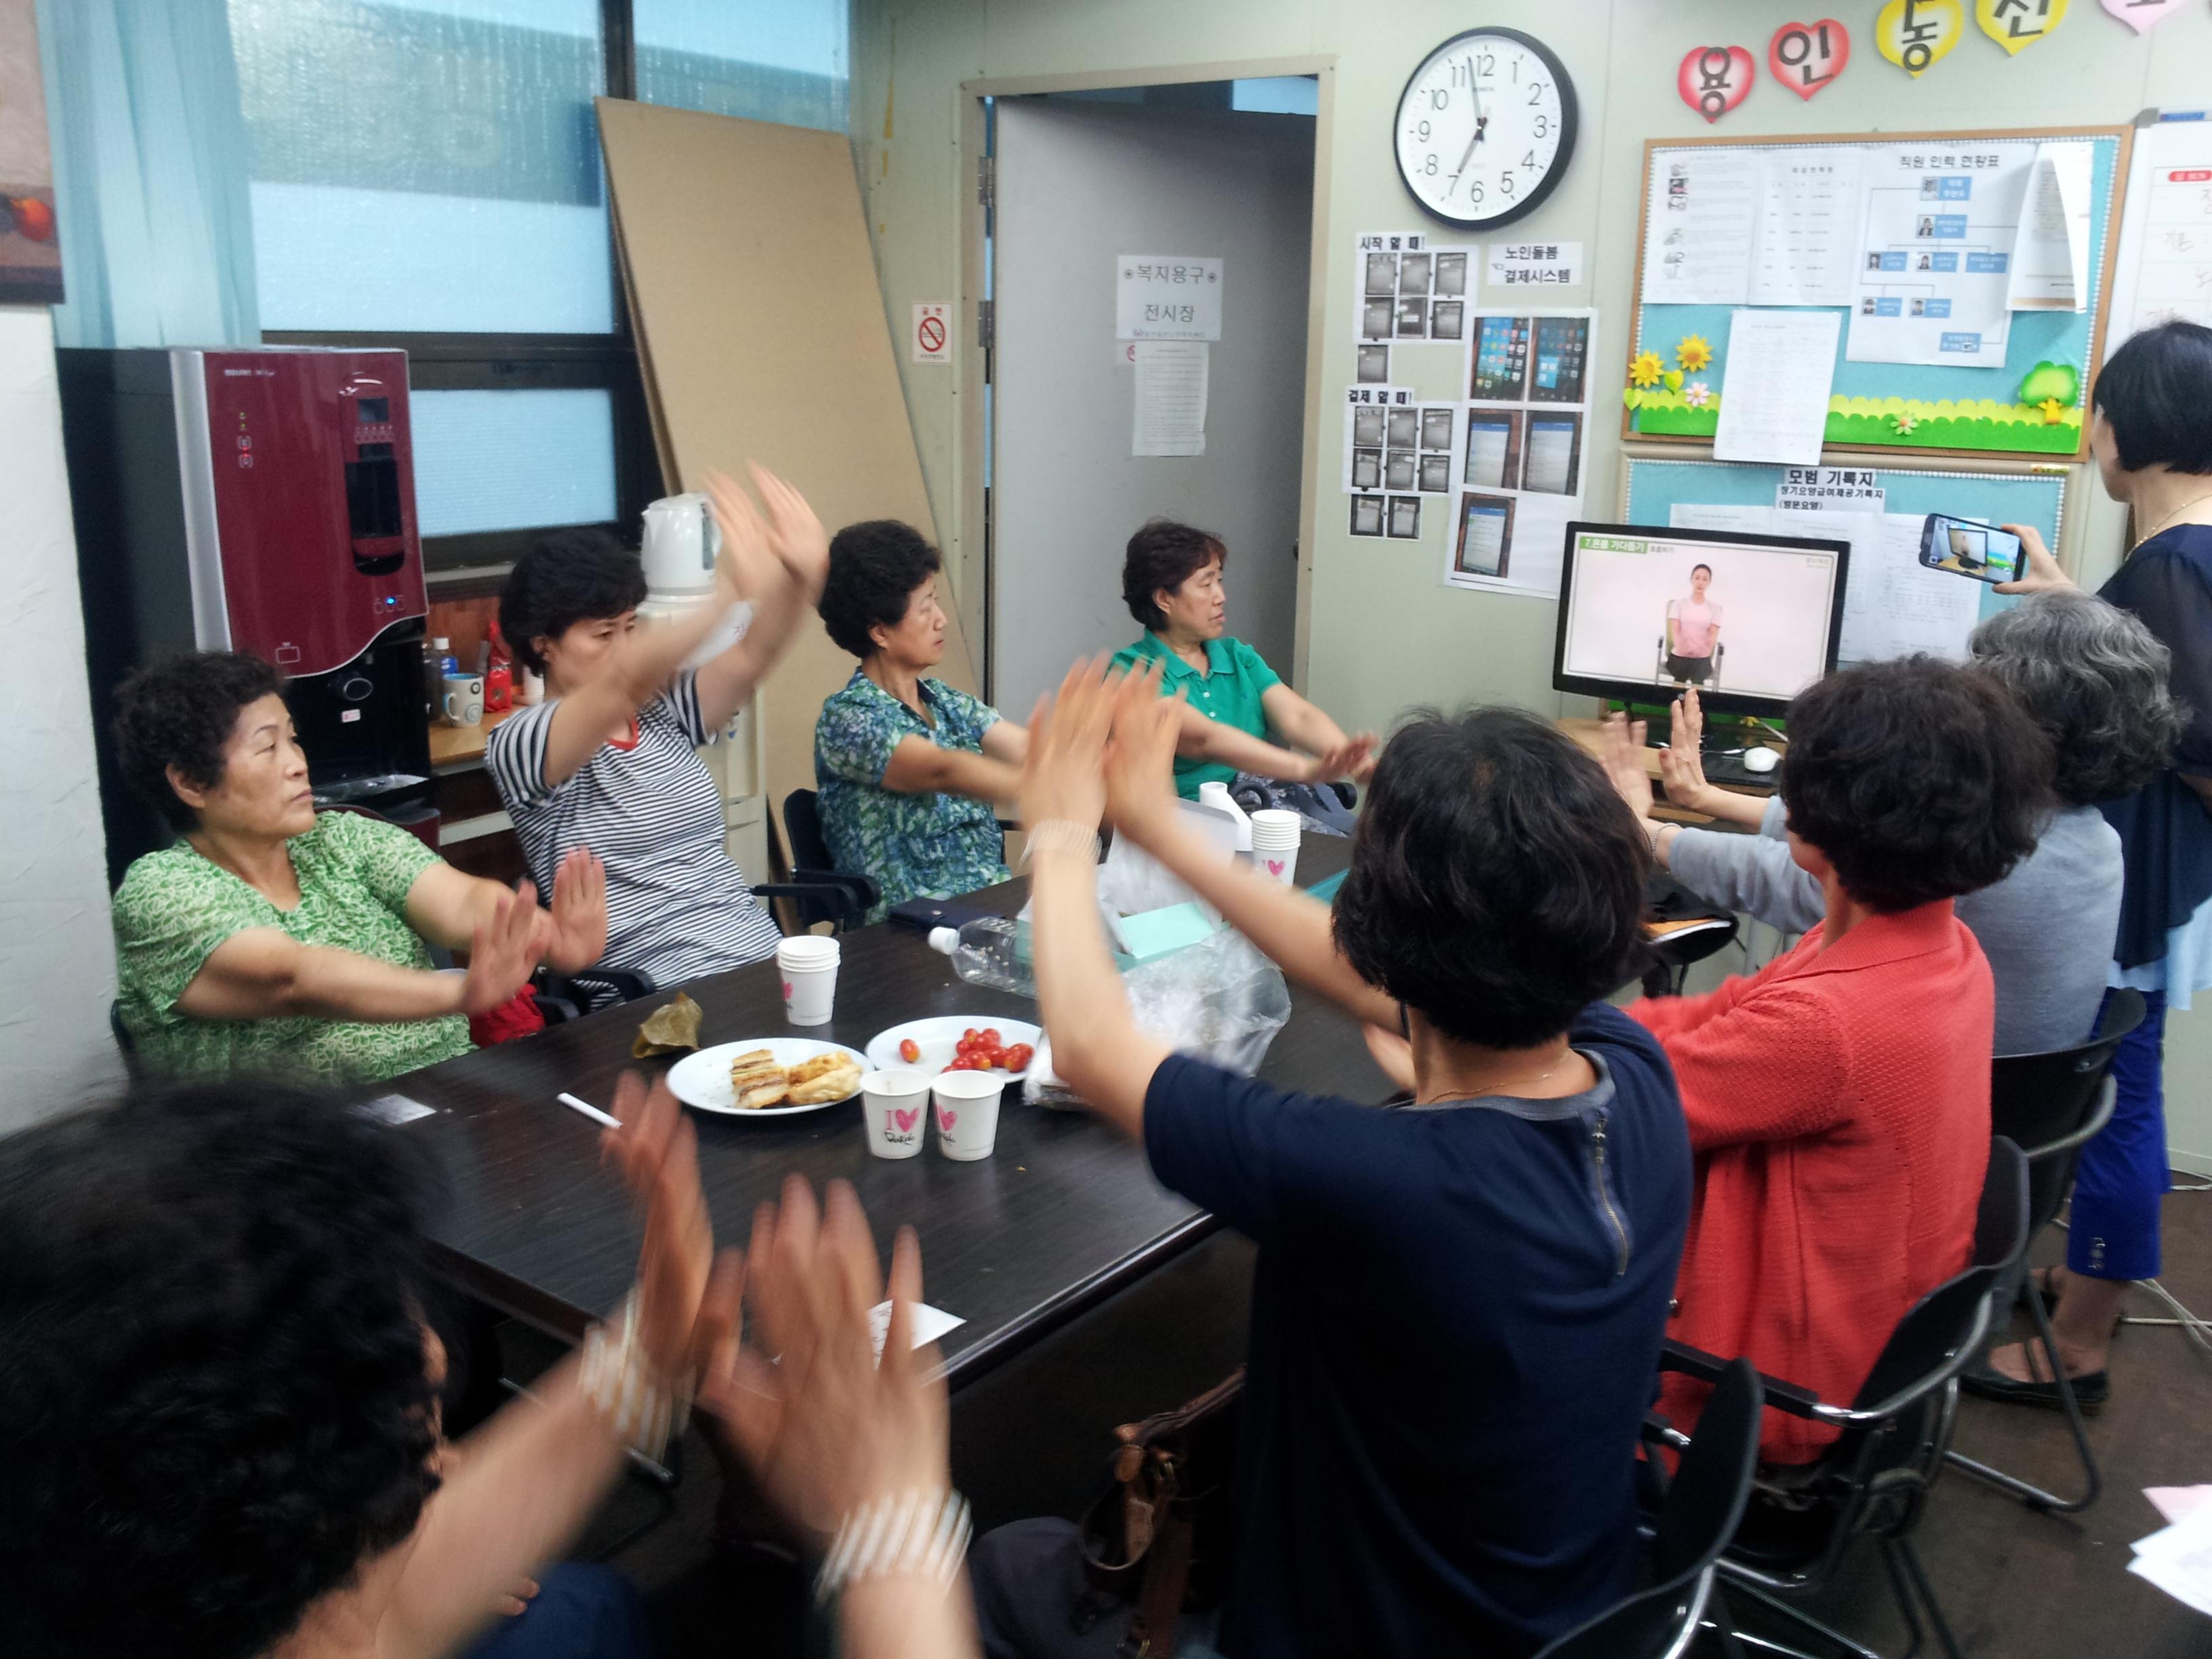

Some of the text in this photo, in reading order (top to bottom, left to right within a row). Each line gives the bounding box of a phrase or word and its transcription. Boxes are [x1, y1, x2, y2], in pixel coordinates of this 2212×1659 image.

[1452, 65, 1465, 87] 11
[1476, 54, 1495, 77] 12
[1512, 61, 1517, 84] 1
[1700, 46, 1731, 119] 용
[1778, 25, 1834, 85] 인
[1431, 89, 1448, 110] 10
[1528, 83, 1541, 106] 2
[1418, 120, 1431, 142] 9
[1533, 115, 1547, 138] 3
[1425, 154, 1438, 176] 8
[1521, 150, 1536, 171] 4
[1448, 174, 1460, 197] 7
[1471, 181, 1484, 203] 6
[1500, 171, 1514, 194] 5
[1359, 237, 1382, 251] 시작
[1505, 246, 1558, 260] 노인돌봄
[1138, 264, 1204, 285] 복지용구
[1504, 269, 1570, 284] 결제시스템
[1144, 304, 1195, 323] 전시장
[1788, 469, 1873, 487] 모범 기록지
